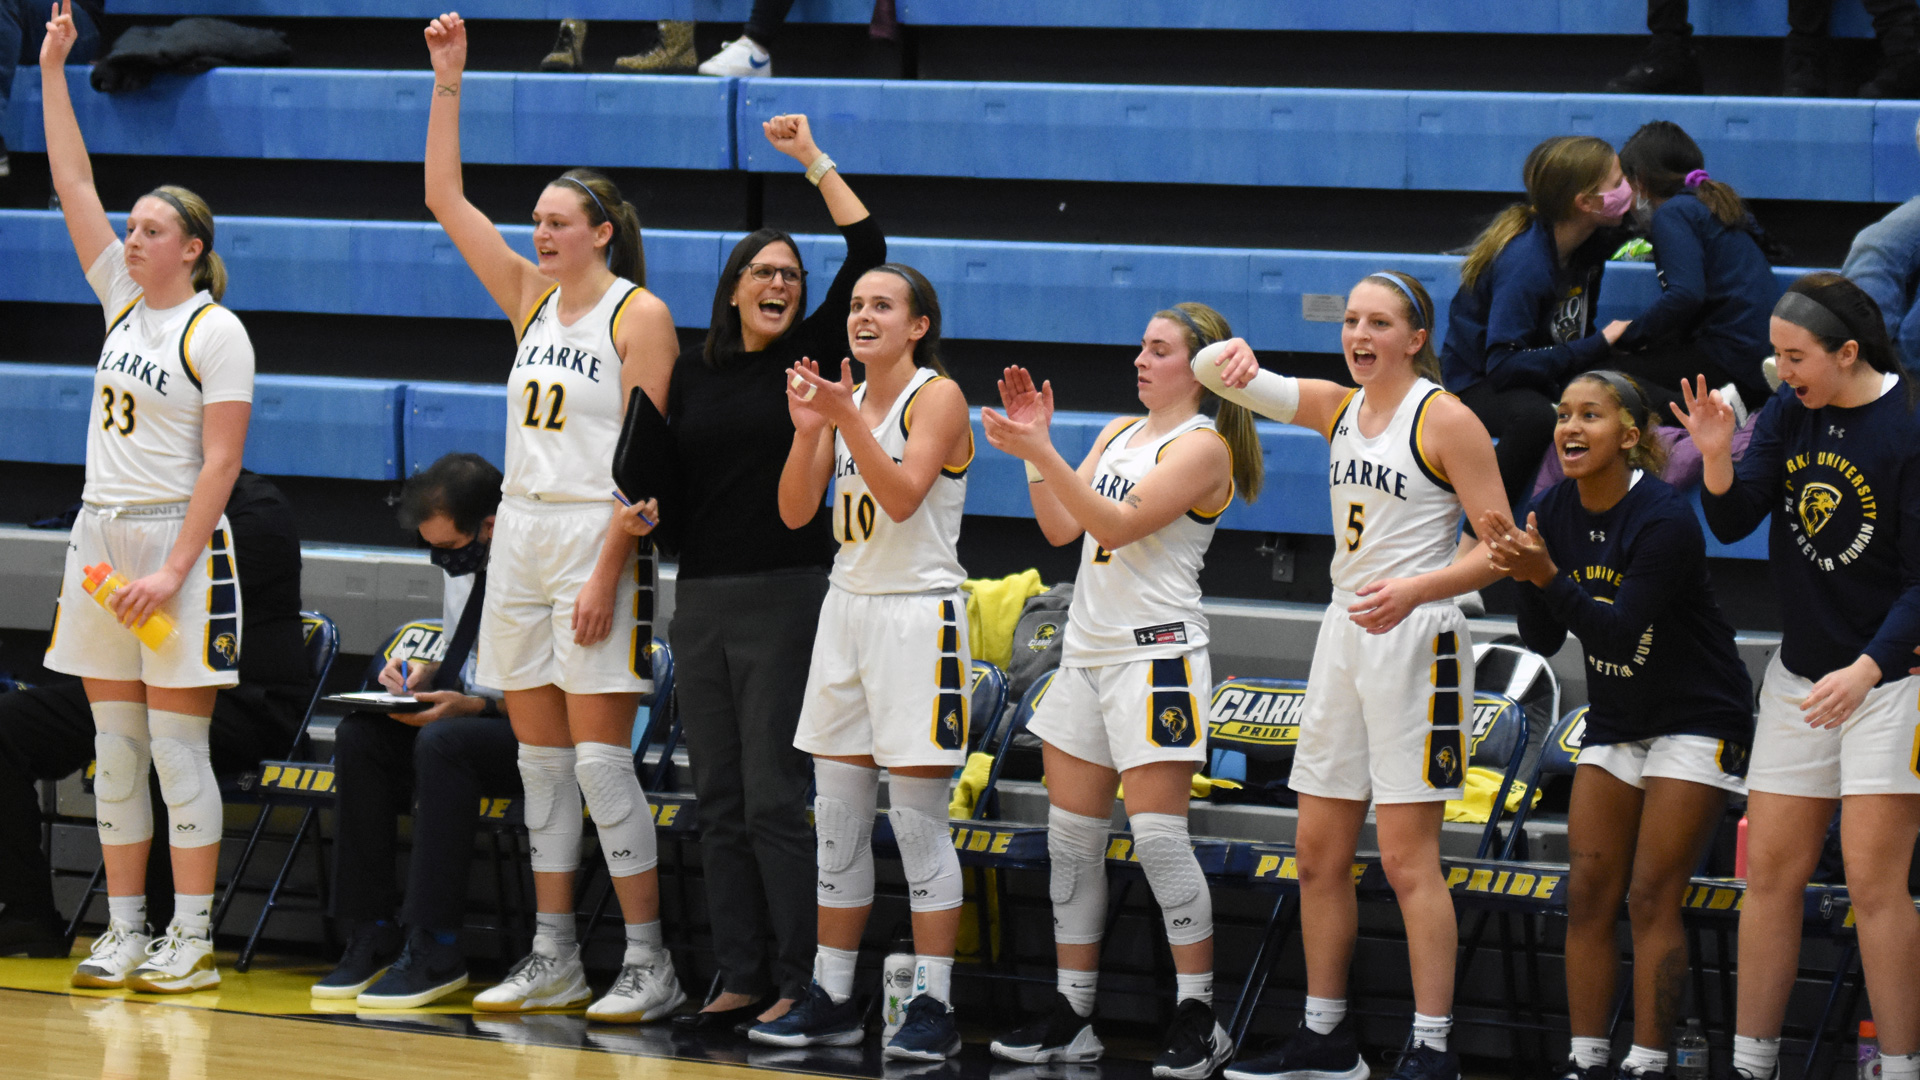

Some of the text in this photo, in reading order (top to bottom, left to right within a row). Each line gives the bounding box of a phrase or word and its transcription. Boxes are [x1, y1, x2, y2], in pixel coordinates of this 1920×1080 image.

[97, 350, 170, 397] LARKE
[101, 384, 136, 437] 33
[521, 378, 567, 432] 22
[1817, 452, 1877, 520] UNIVERSITY
[842, 492, 876, 543] 10
[1345, 501, 1365, 553] 5
[1838, 523, 1875, 565] HUMAN
[1209, 689, 1305, 725] CLARK
[1237, 725, 1291, 738] PRIDE
[261, 766, 336, 793] PRID
[1446, 867, 1561, 899] PRIDE
